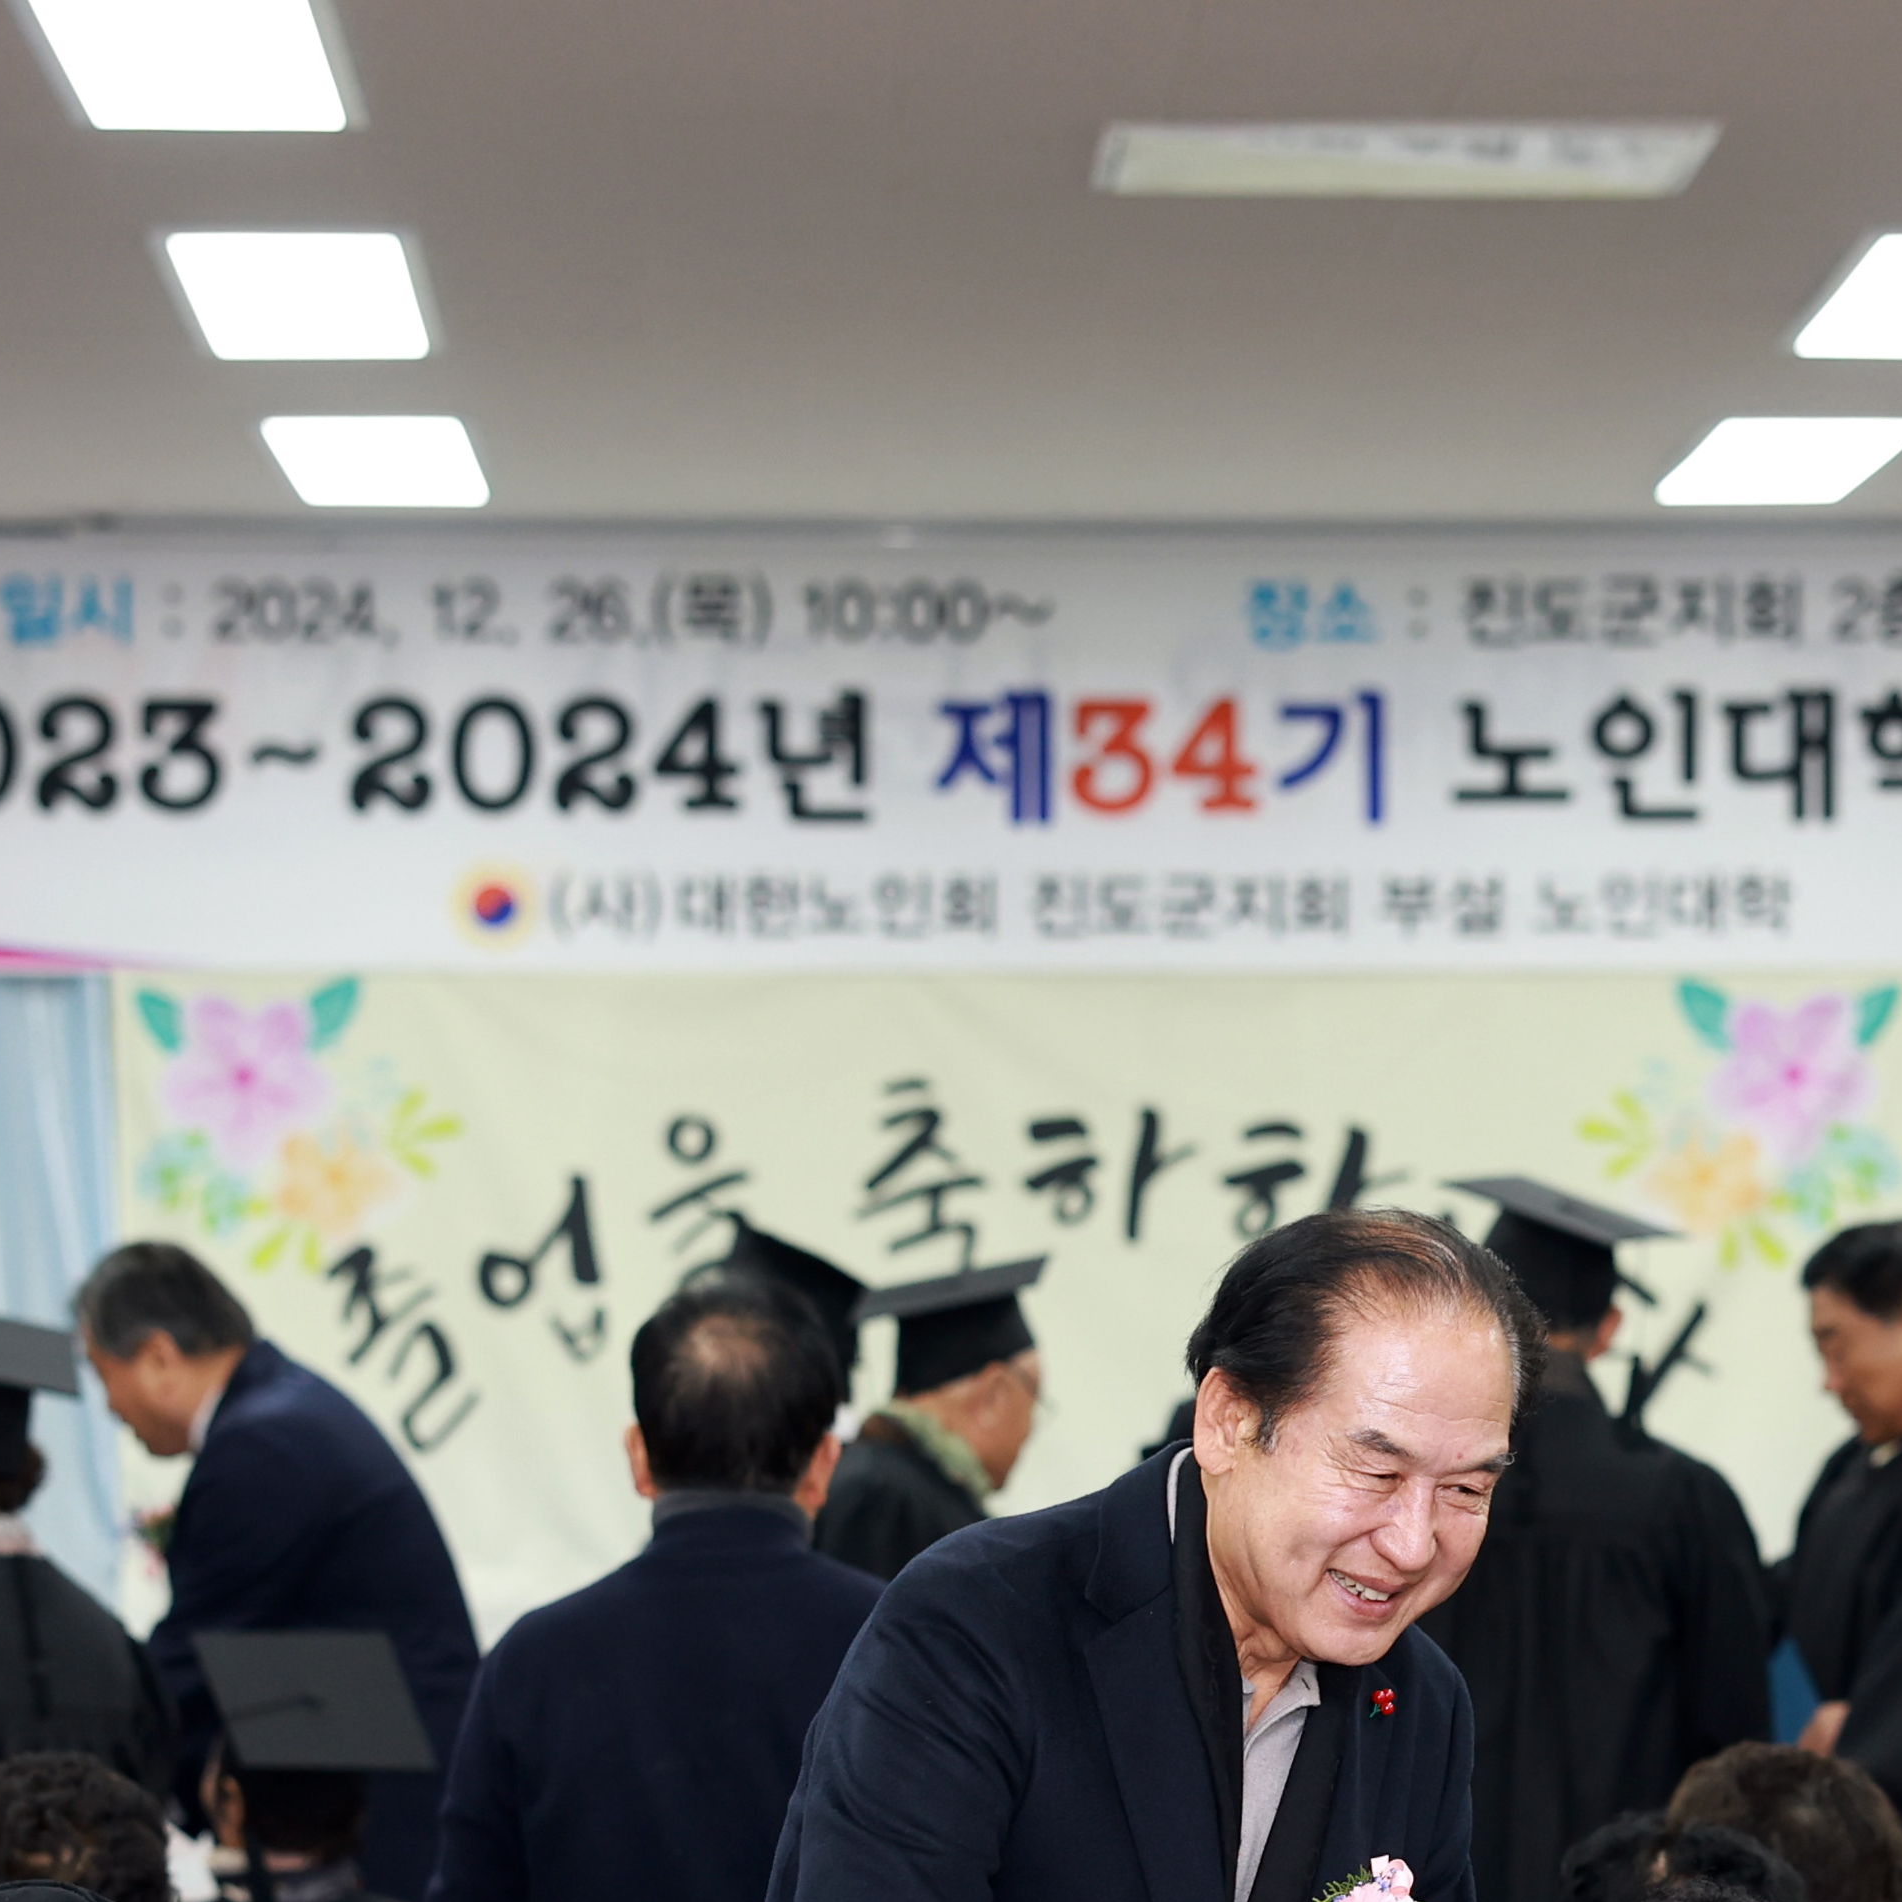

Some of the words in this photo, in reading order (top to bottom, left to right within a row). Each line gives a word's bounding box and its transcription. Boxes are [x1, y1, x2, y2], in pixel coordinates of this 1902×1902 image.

[1245, 576, 1383, 652] 장소
[1462, 572, 1802, 652] 진도군지회
[935, 688, 1387, 824] 제34기
[1031, 870, 1351, 940] 진도군지회
[1379, 870, 1506, 938] 부설
[1534, 870, 1795, 940] 노인대학
